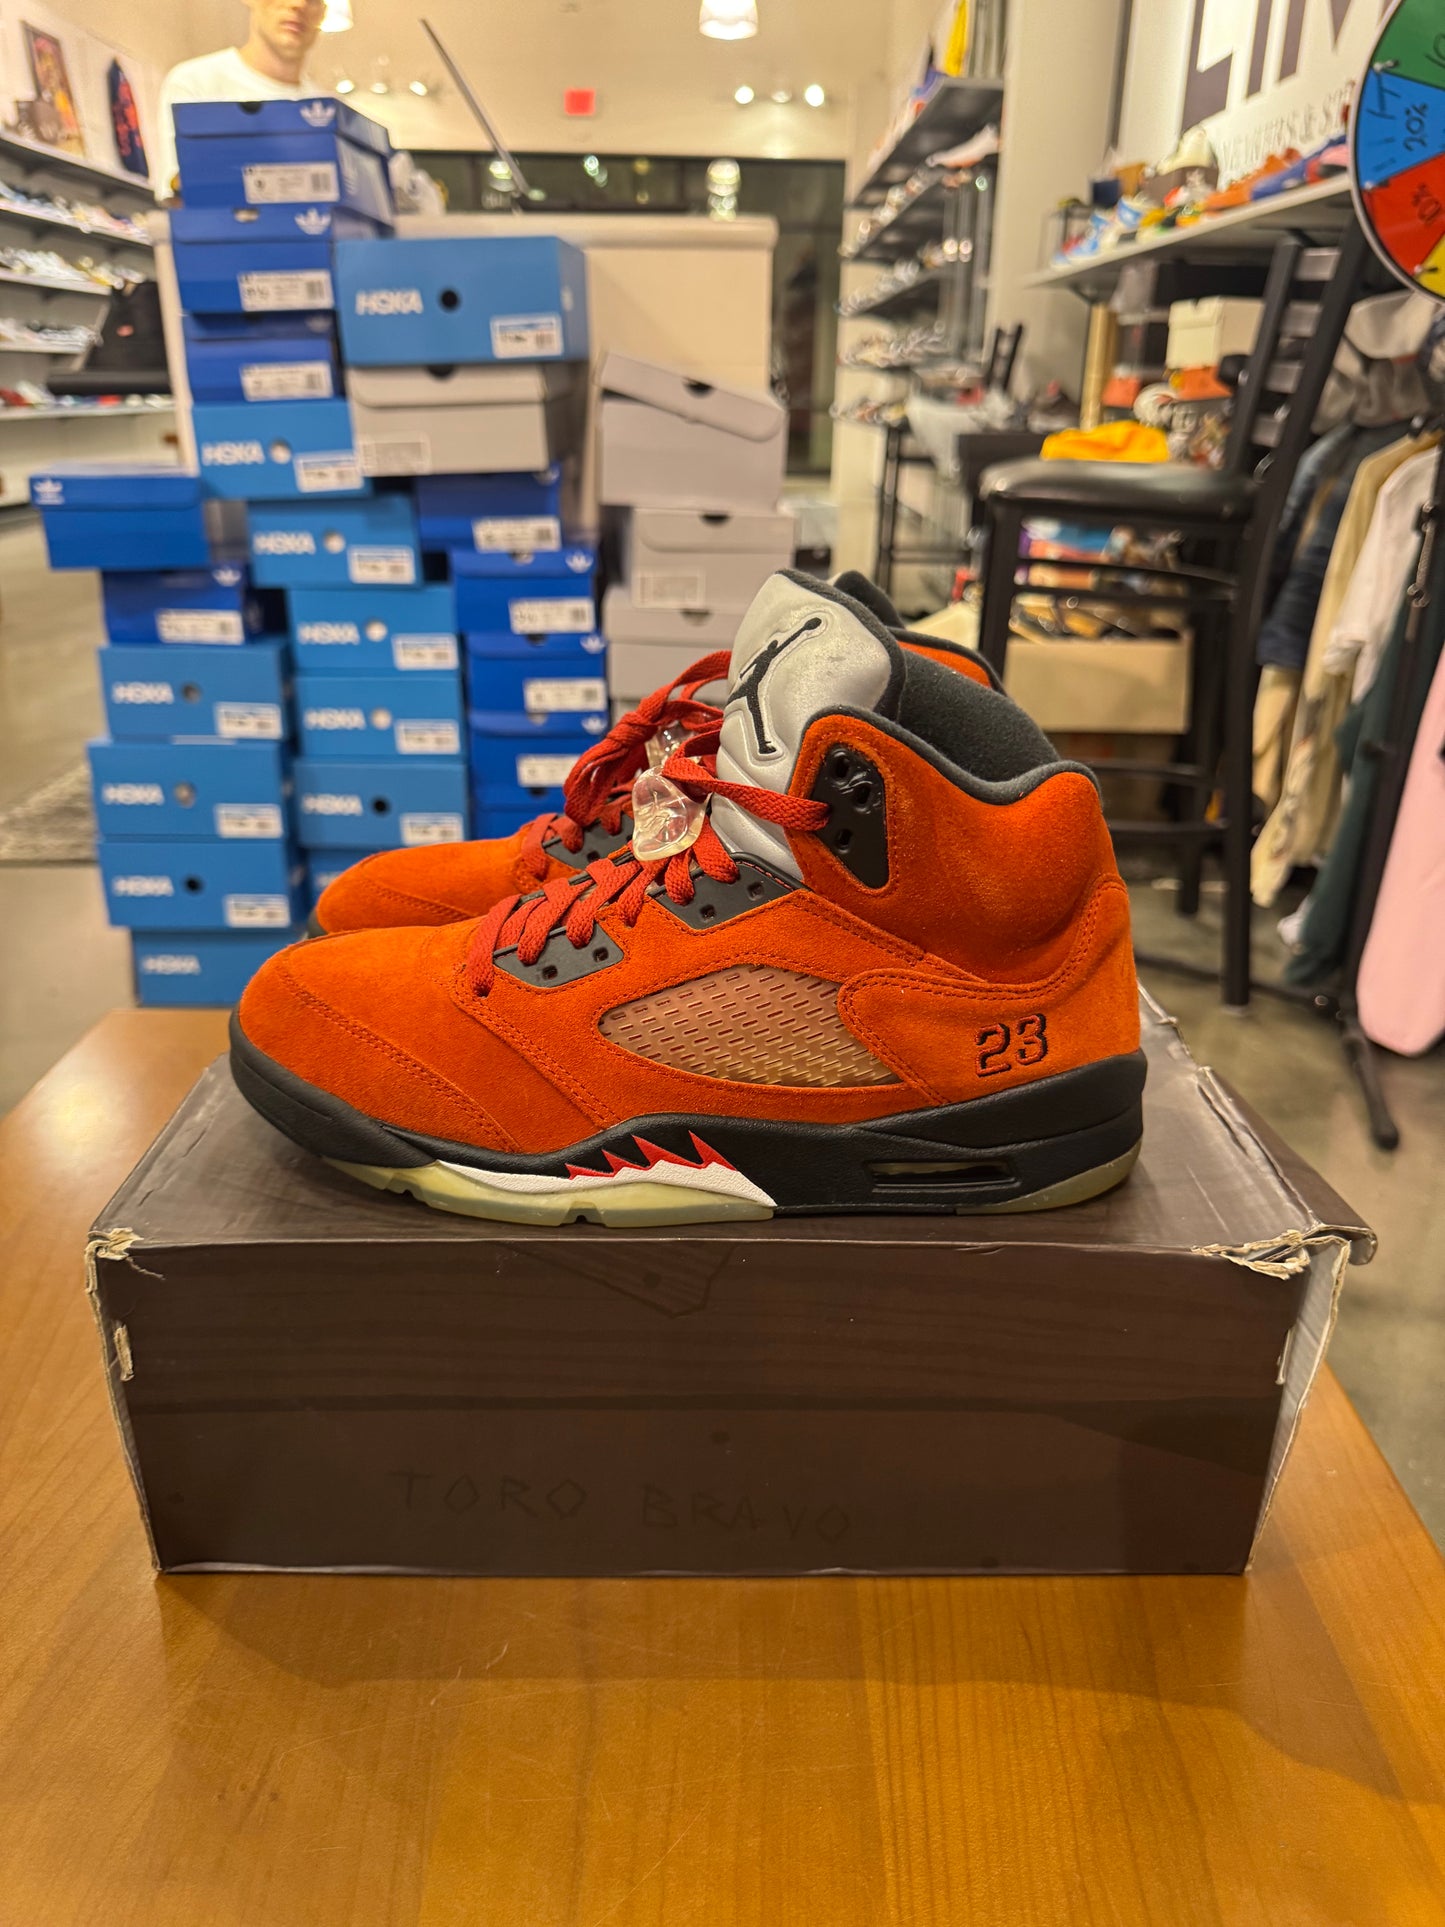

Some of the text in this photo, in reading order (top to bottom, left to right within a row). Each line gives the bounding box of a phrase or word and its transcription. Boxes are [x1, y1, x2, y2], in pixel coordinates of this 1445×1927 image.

[1402, 102, 1430, 153] 20%
[355, 289, 423, 315] HOKA
[202, 440, 265, 466] HOKA
[253, 529, 315, 555] HOKA
[975, 1013, 1048, 1078] 23
[388, 1470, 852, 1546] TORO BRAVO
